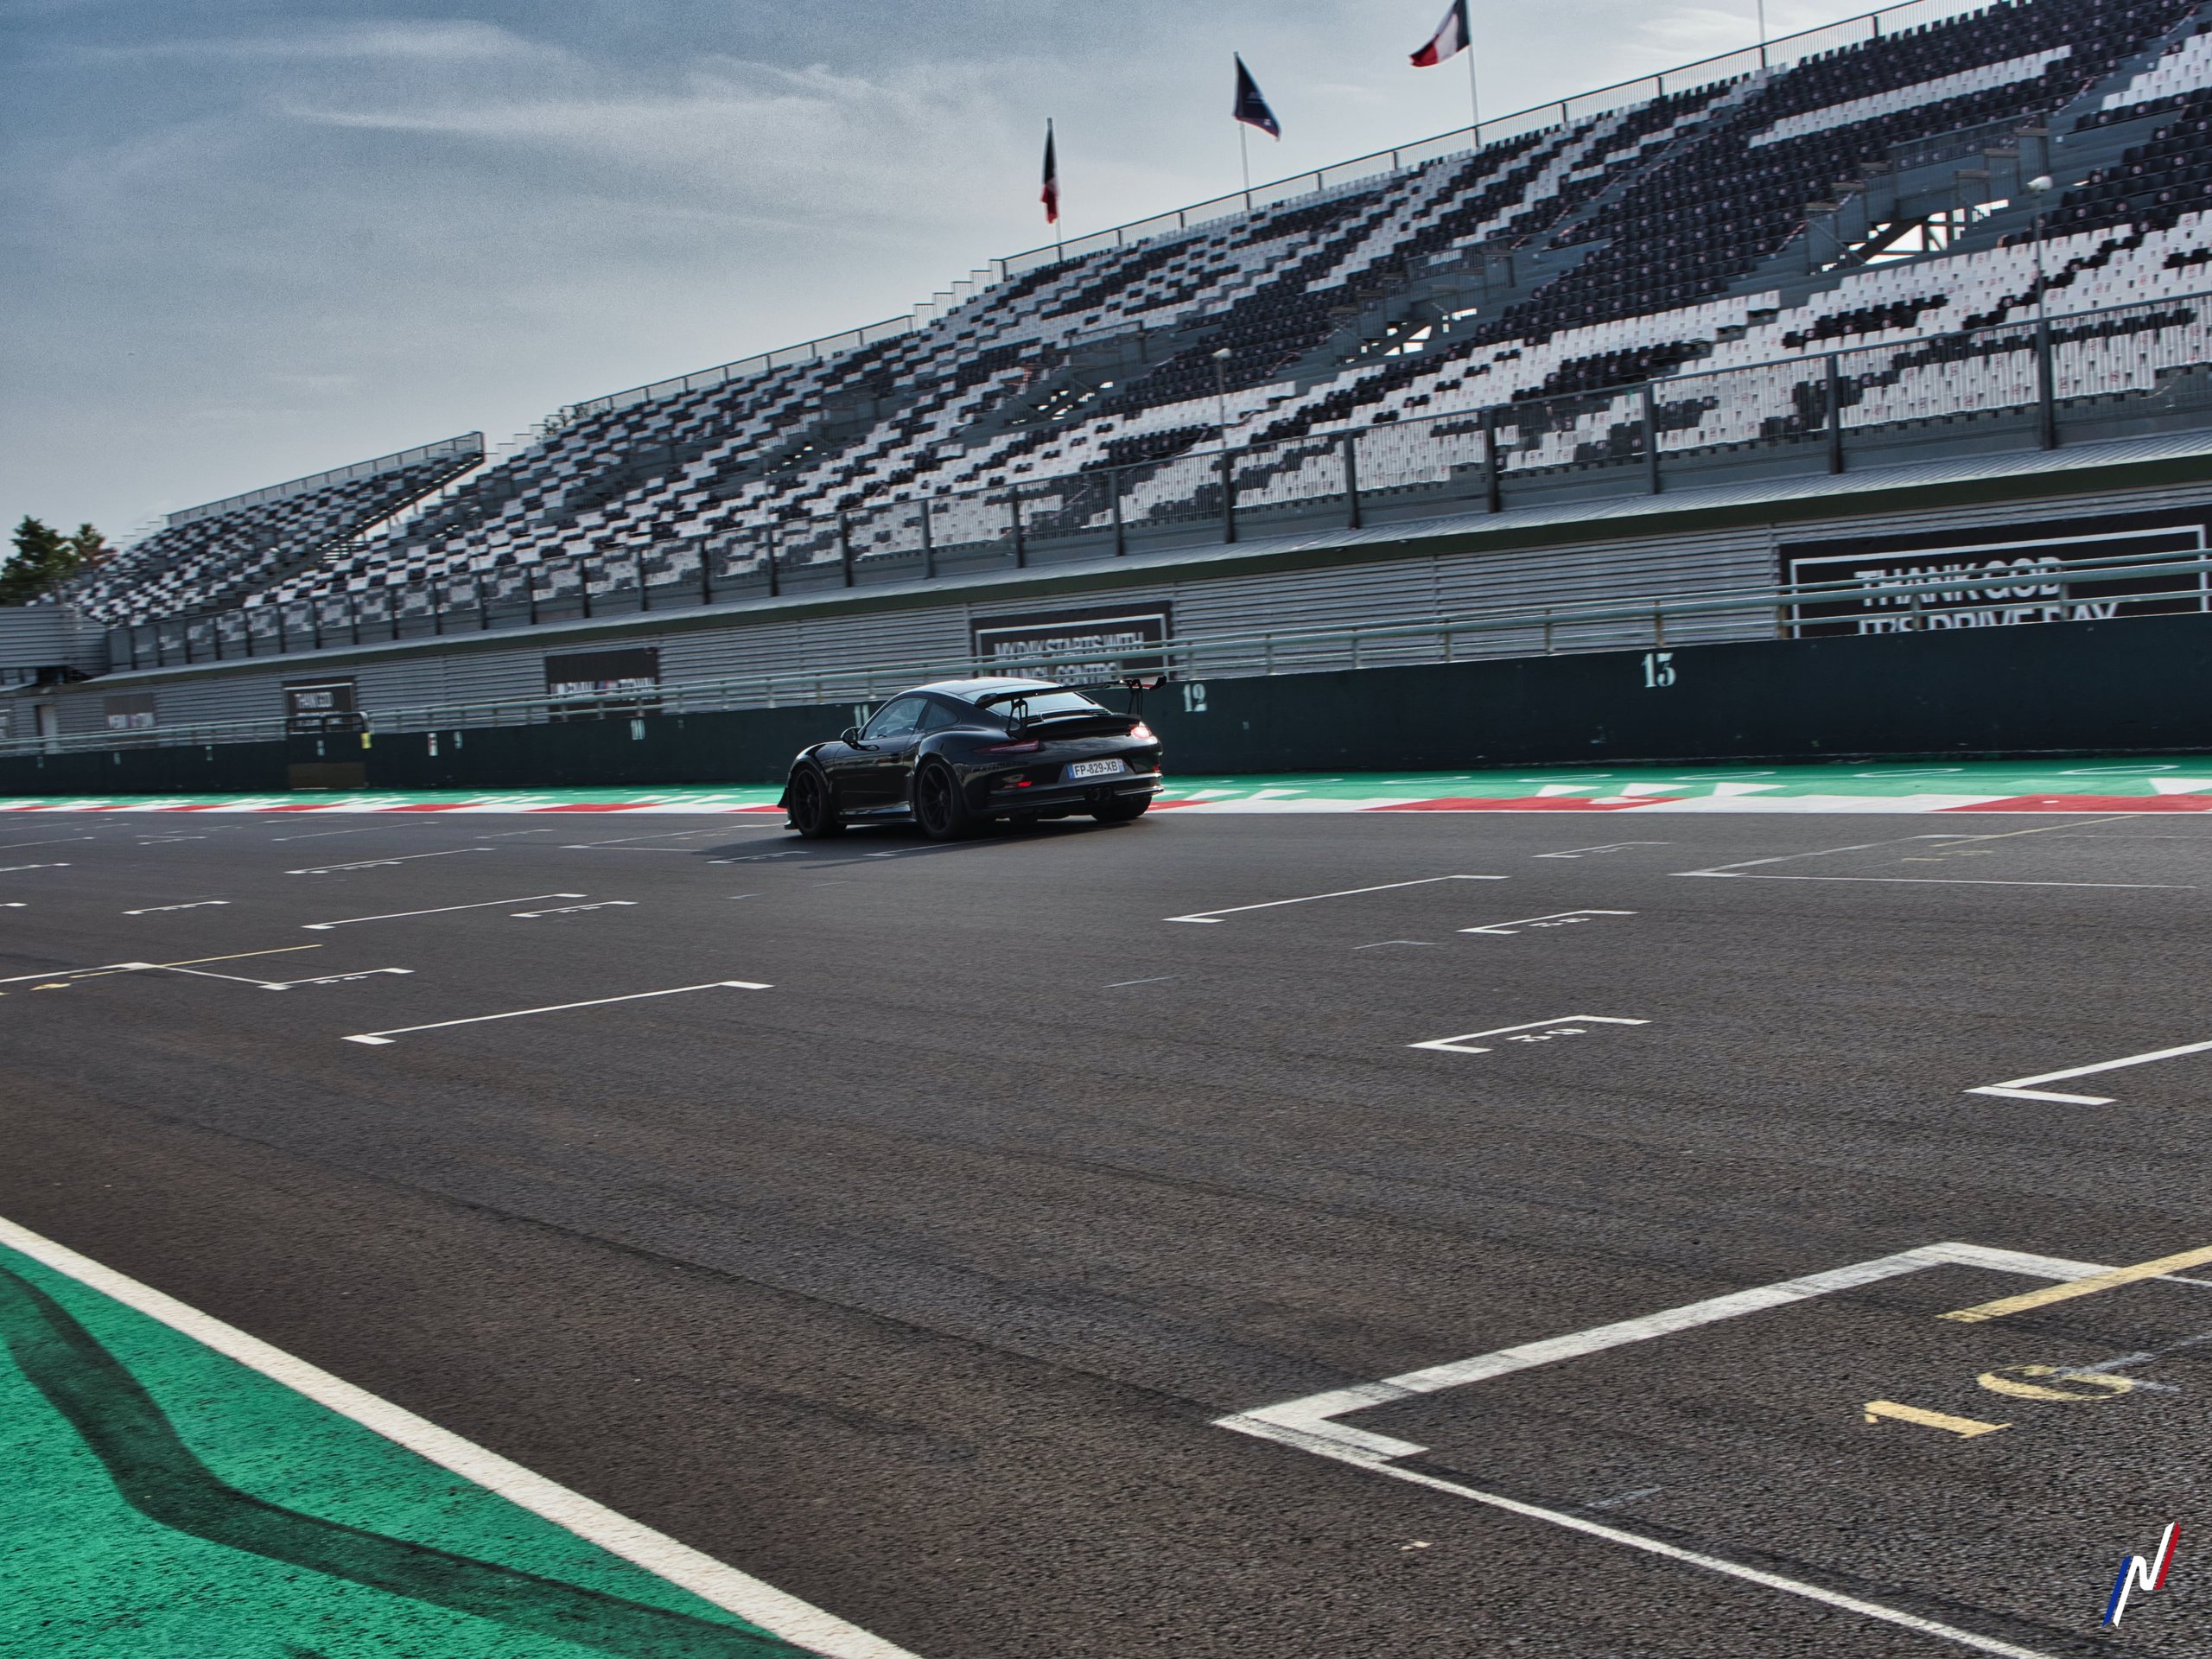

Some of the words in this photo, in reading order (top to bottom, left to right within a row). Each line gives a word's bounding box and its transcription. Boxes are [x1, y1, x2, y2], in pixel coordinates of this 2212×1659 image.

[1854, 563, 1980, 607] THANK
[1982, 556, 2063, 600] GOD
[1641, 652, 1676, 688] 13
[1183, 683, 1207, 713] 12
[1074, 761, 1118, 777] FP-829-XB
[1864, 1364, 2136, 1439] 16
